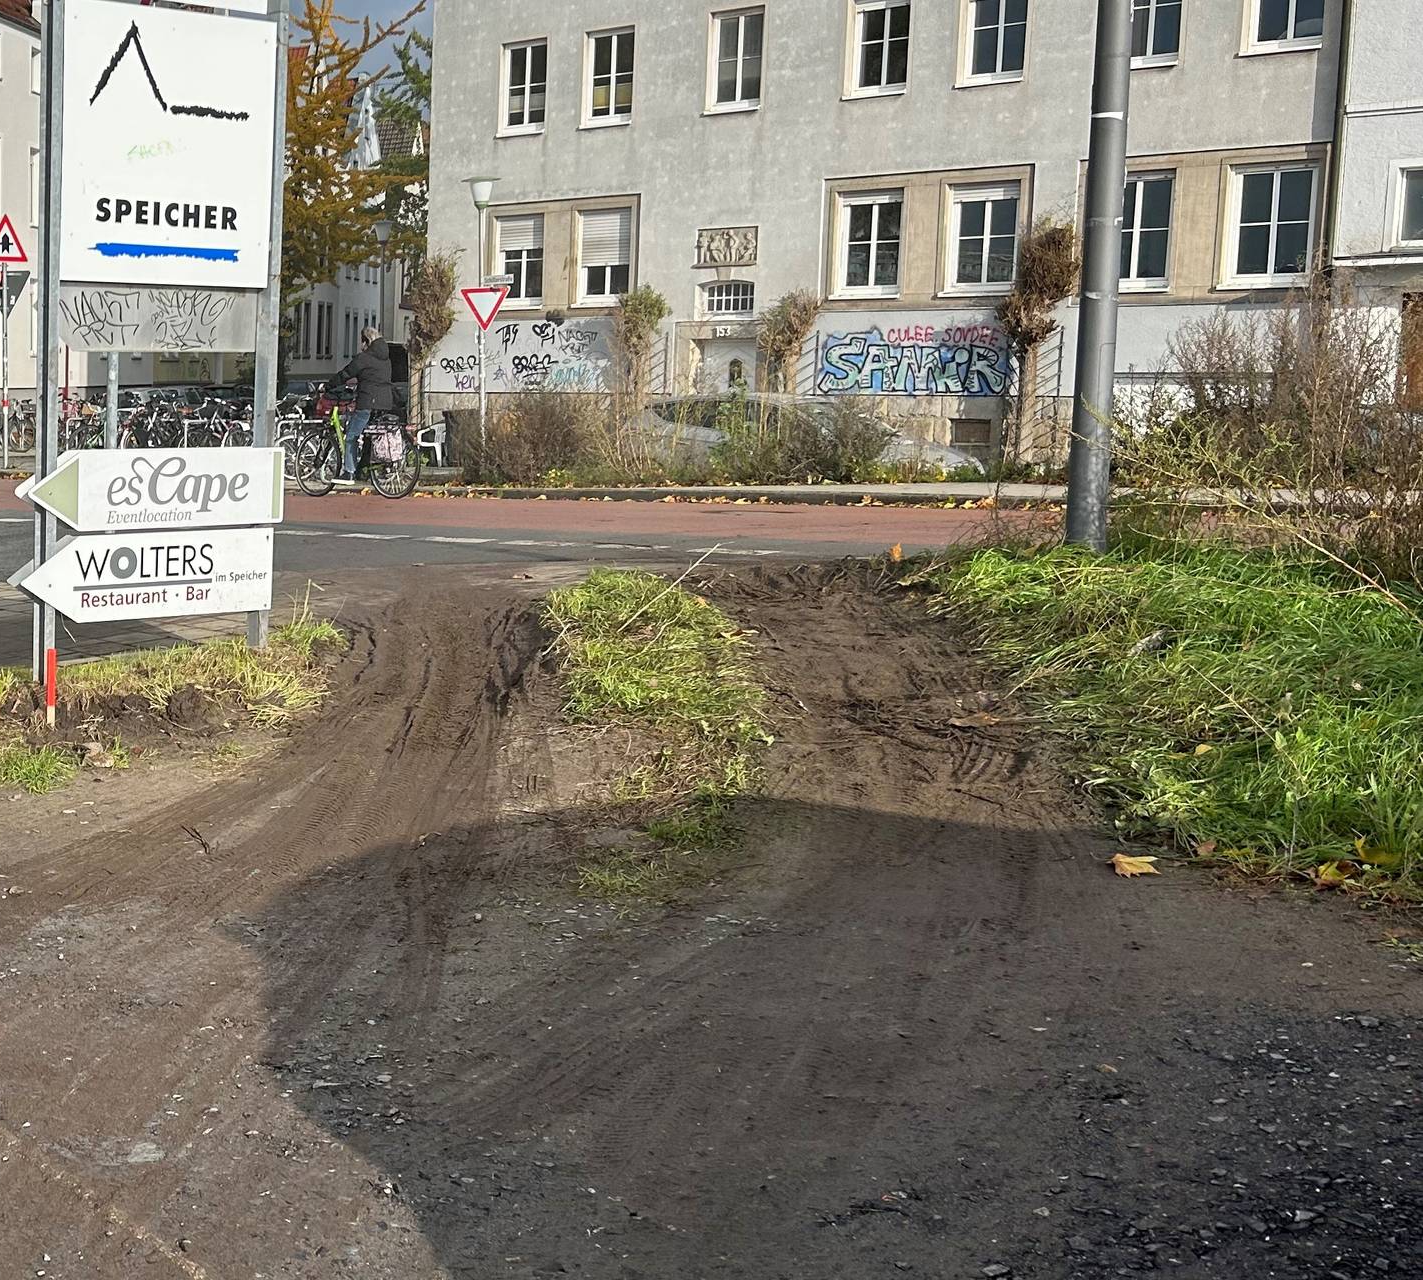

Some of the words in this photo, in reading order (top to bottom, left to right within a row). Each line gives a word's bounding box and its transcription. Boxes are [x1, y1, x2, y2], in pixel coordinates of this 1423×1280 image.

[95, 197, 238, 231] SPEICHER
[715, 325, 731, 338] 153
[106, 456, 250, 513] esCape
[106, 507, 193, 525] Eventlocation
[74, 543, 214, 582] WOLTERS
[214, 571, 227, 583] im
[228, 570, 268, 584] Speicher
[80, 586, 168, 608] Restaurant
[185, 585, 211, 601] Bar
